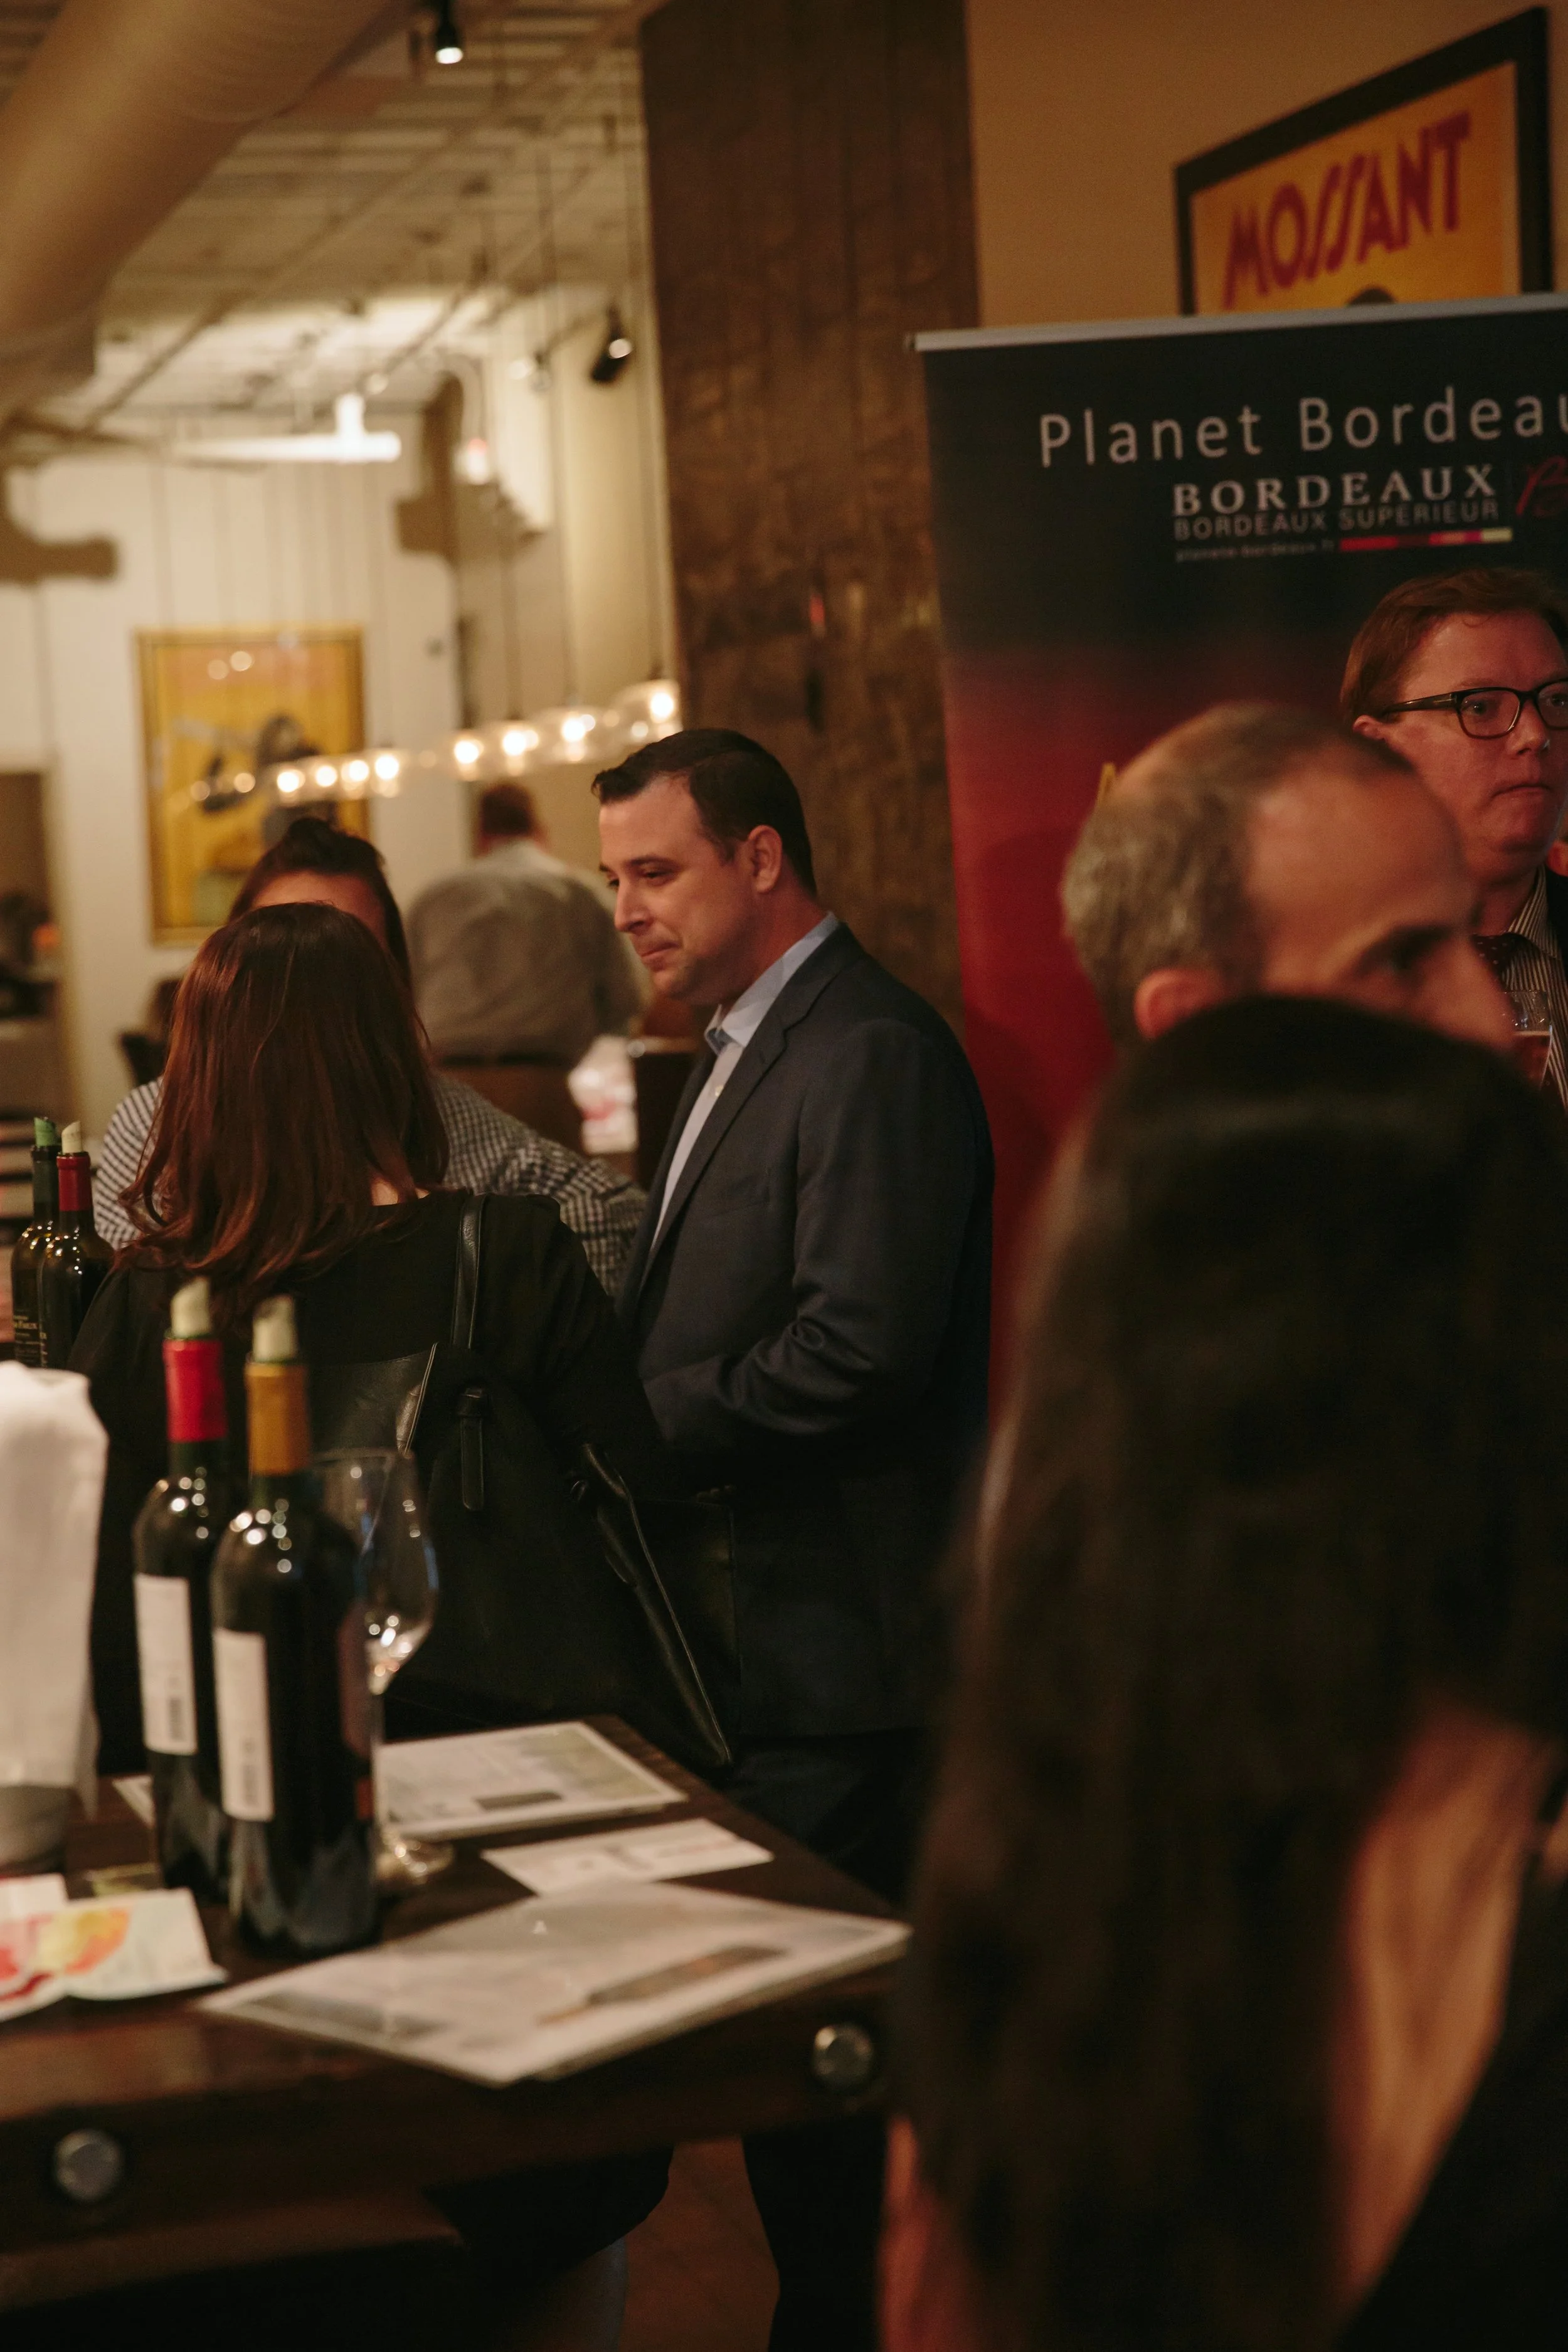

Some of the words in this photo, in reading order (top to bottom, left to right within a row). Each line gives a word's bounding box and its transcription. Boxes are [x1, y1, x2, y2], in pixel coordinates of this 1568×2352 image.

[1041, 405, 1263, 467] Planet
[1174, 464, 1495, 516] BORDEAUX
[1175, 516, 1327, 541] BORDEAUX
